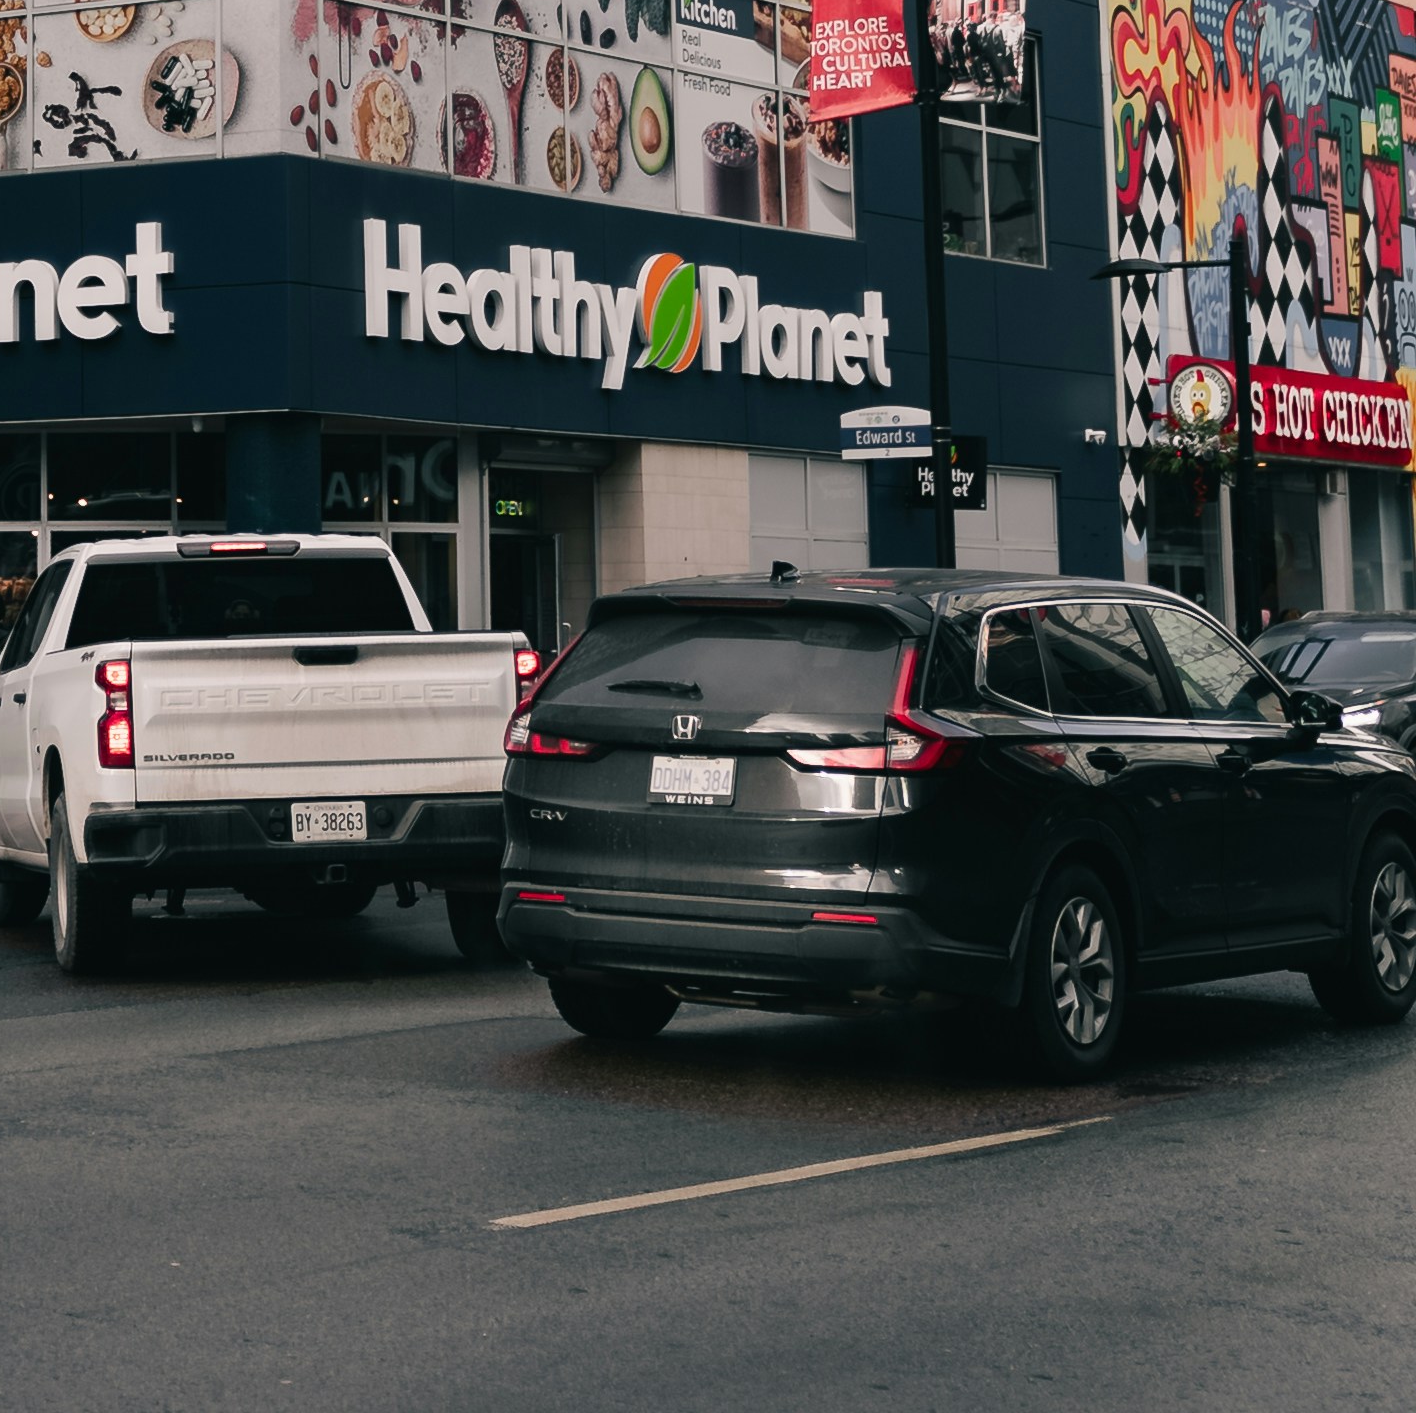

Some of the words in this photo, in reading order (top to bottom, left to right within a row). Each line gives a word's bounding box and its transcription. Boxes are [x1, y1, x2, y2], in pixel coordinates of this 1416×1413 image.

[815, 16, 888, 39] EXPLORE
[682, 30, 702, 48] Real
[810, 33, 905, 57] TORONTO'S
[682, 48, 722, 70] Delicious
[822, 51, 912, 72] CULTURAL
[683, 74, 707, 92] Fresh
[709, 79, 731, 97] Food
[813, 71, 874, 91] HEART
[364, 218, 635, 390] Healthy
[699, 264, 892, 387] Planet
[1272, 383, 1315, 441] HOT
[1322, 389, 1412, 450] CHICKEN
[856, 428, 902, 445] Edward
[905, 431, 916, 443] St
[918, 466, 974, 486] Hethy
[921, 481, 969, 497] Plet
[159, 682, 491, 710] CHEVROLET
[143, 752, 236, 763] SILVERADO
[652, 767, 692, 792] DDHM
[702, 769, 730, 793] 384
[296, 813, 312, 833] BY
[321, 812, 364, 832] 38263
